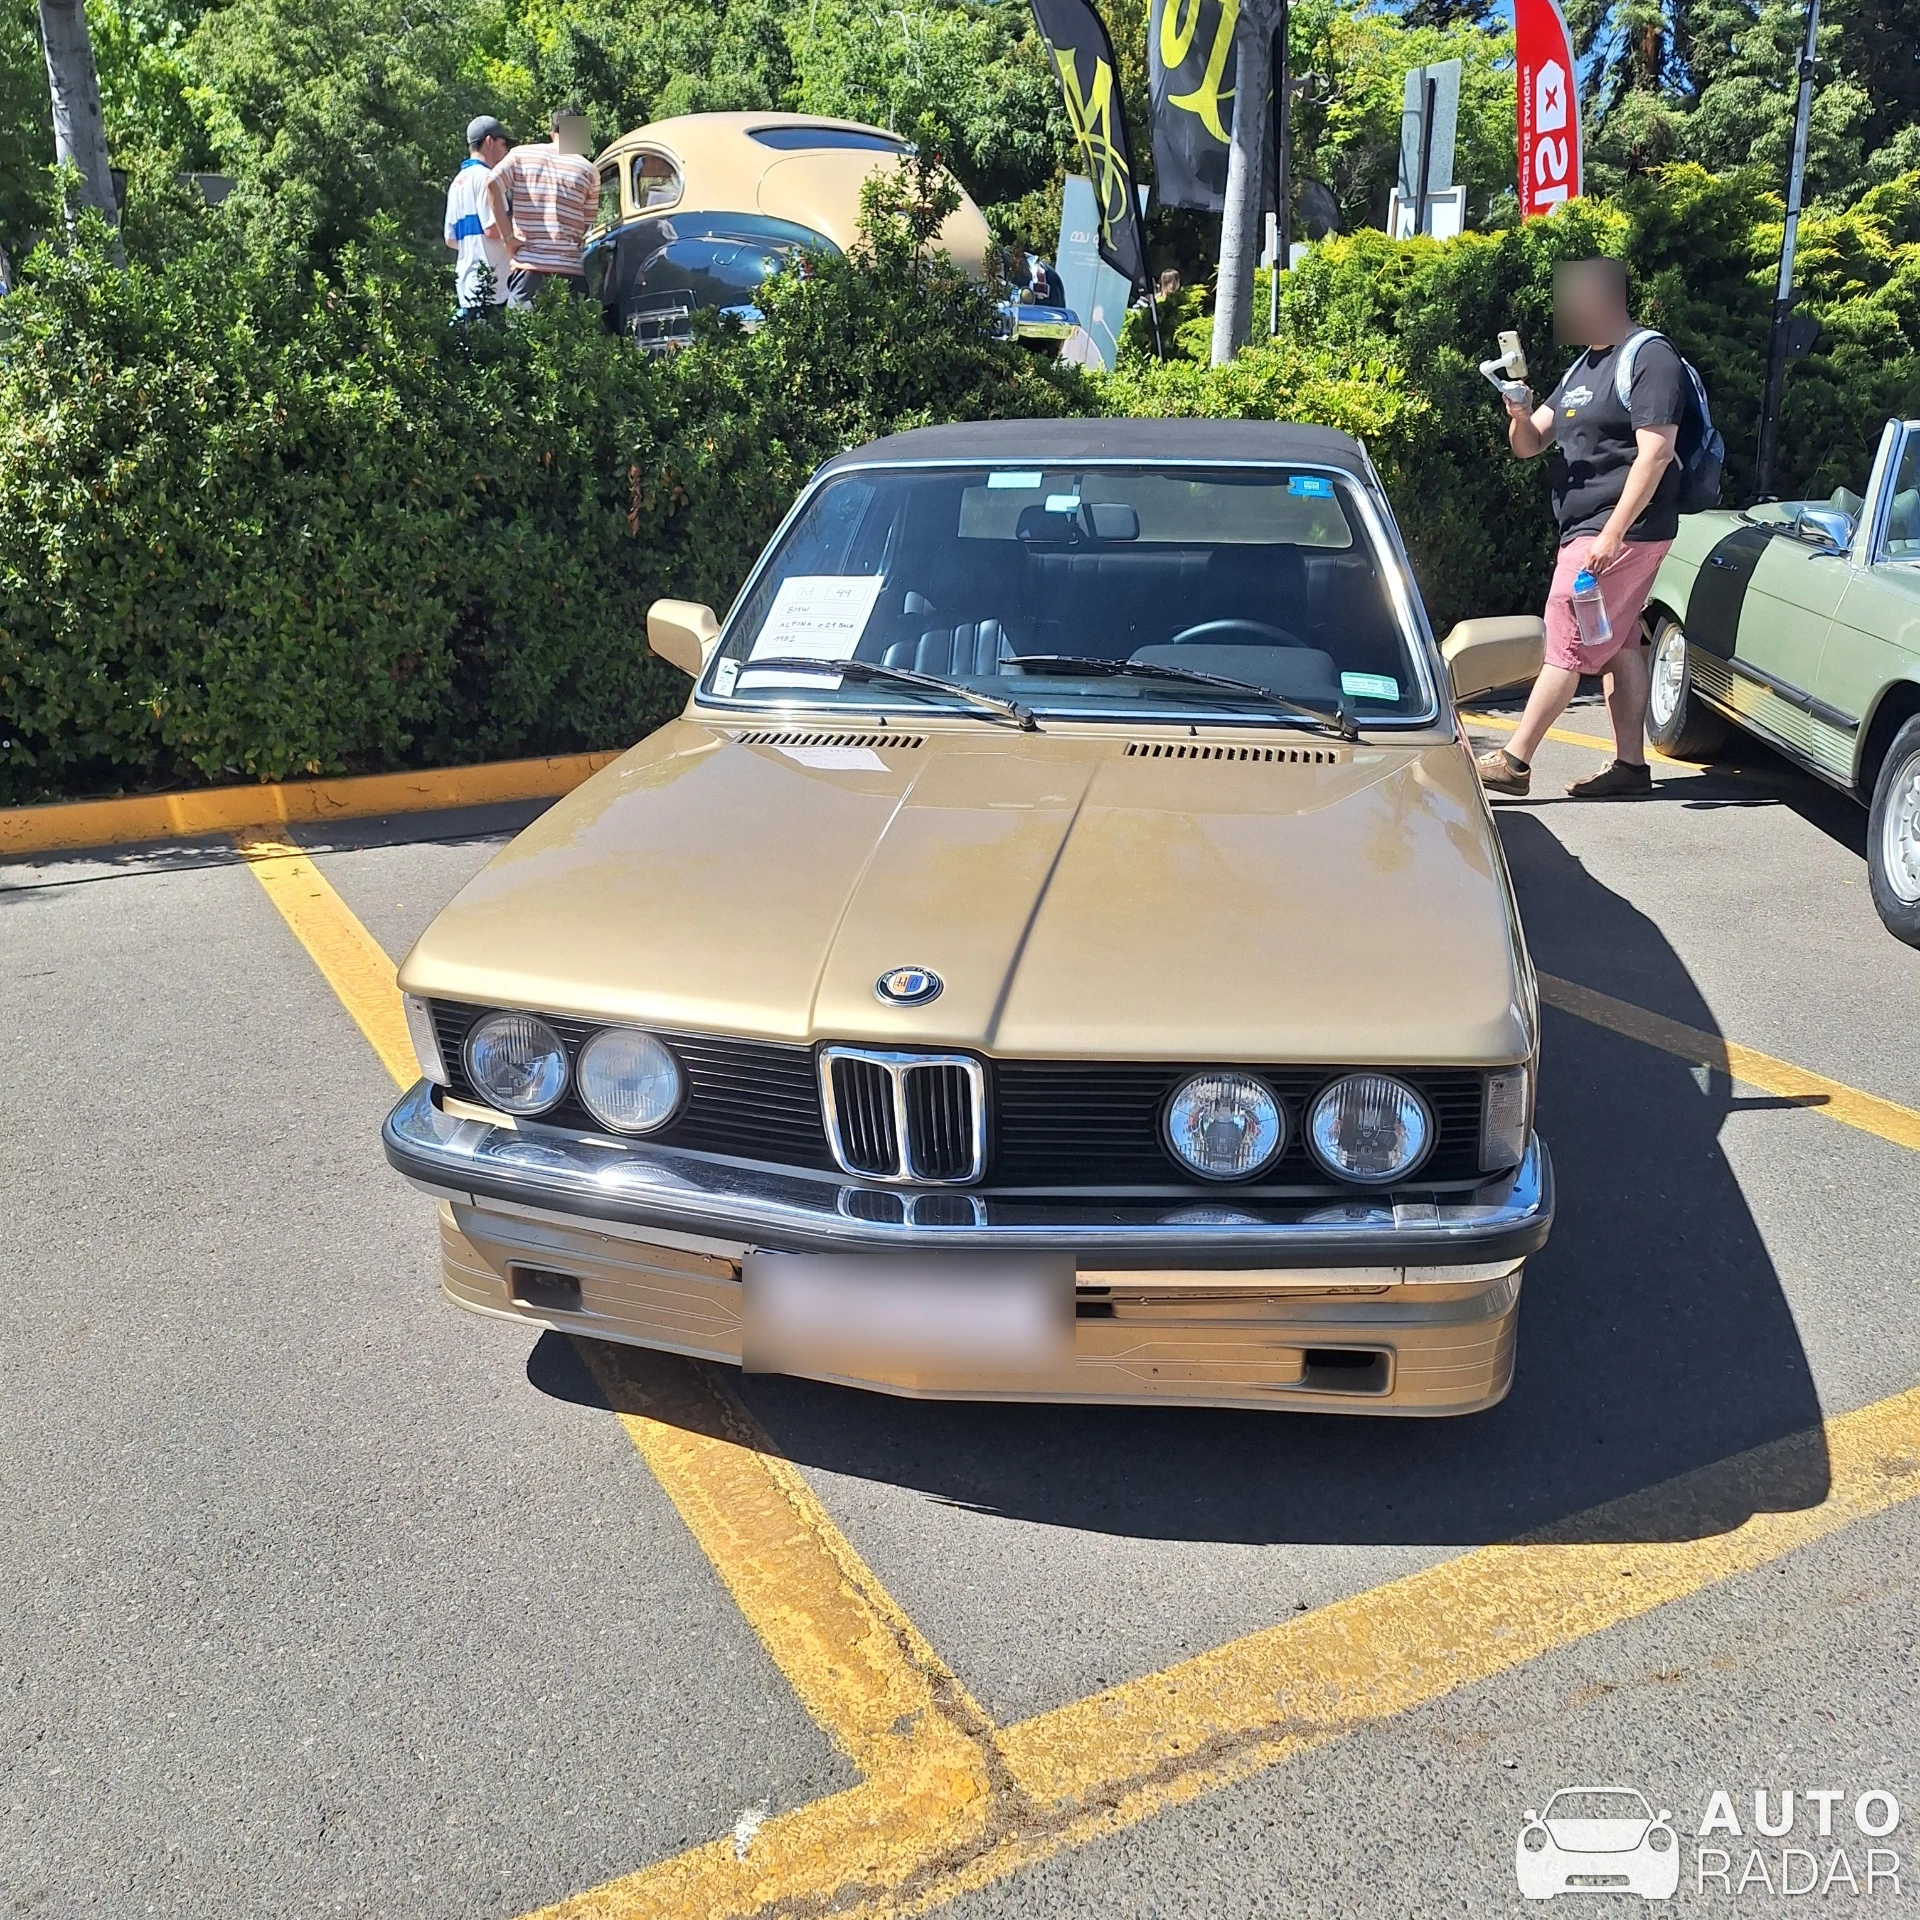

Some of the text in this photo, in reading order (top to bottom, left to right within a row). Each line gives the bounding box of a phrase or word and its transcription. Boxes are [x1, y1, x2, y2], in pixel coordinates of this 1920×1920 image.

[836, 588, 852, 598] 49
[787, 606, 811, 614] BMW
[778, 620, 812, 628] ALPINA
